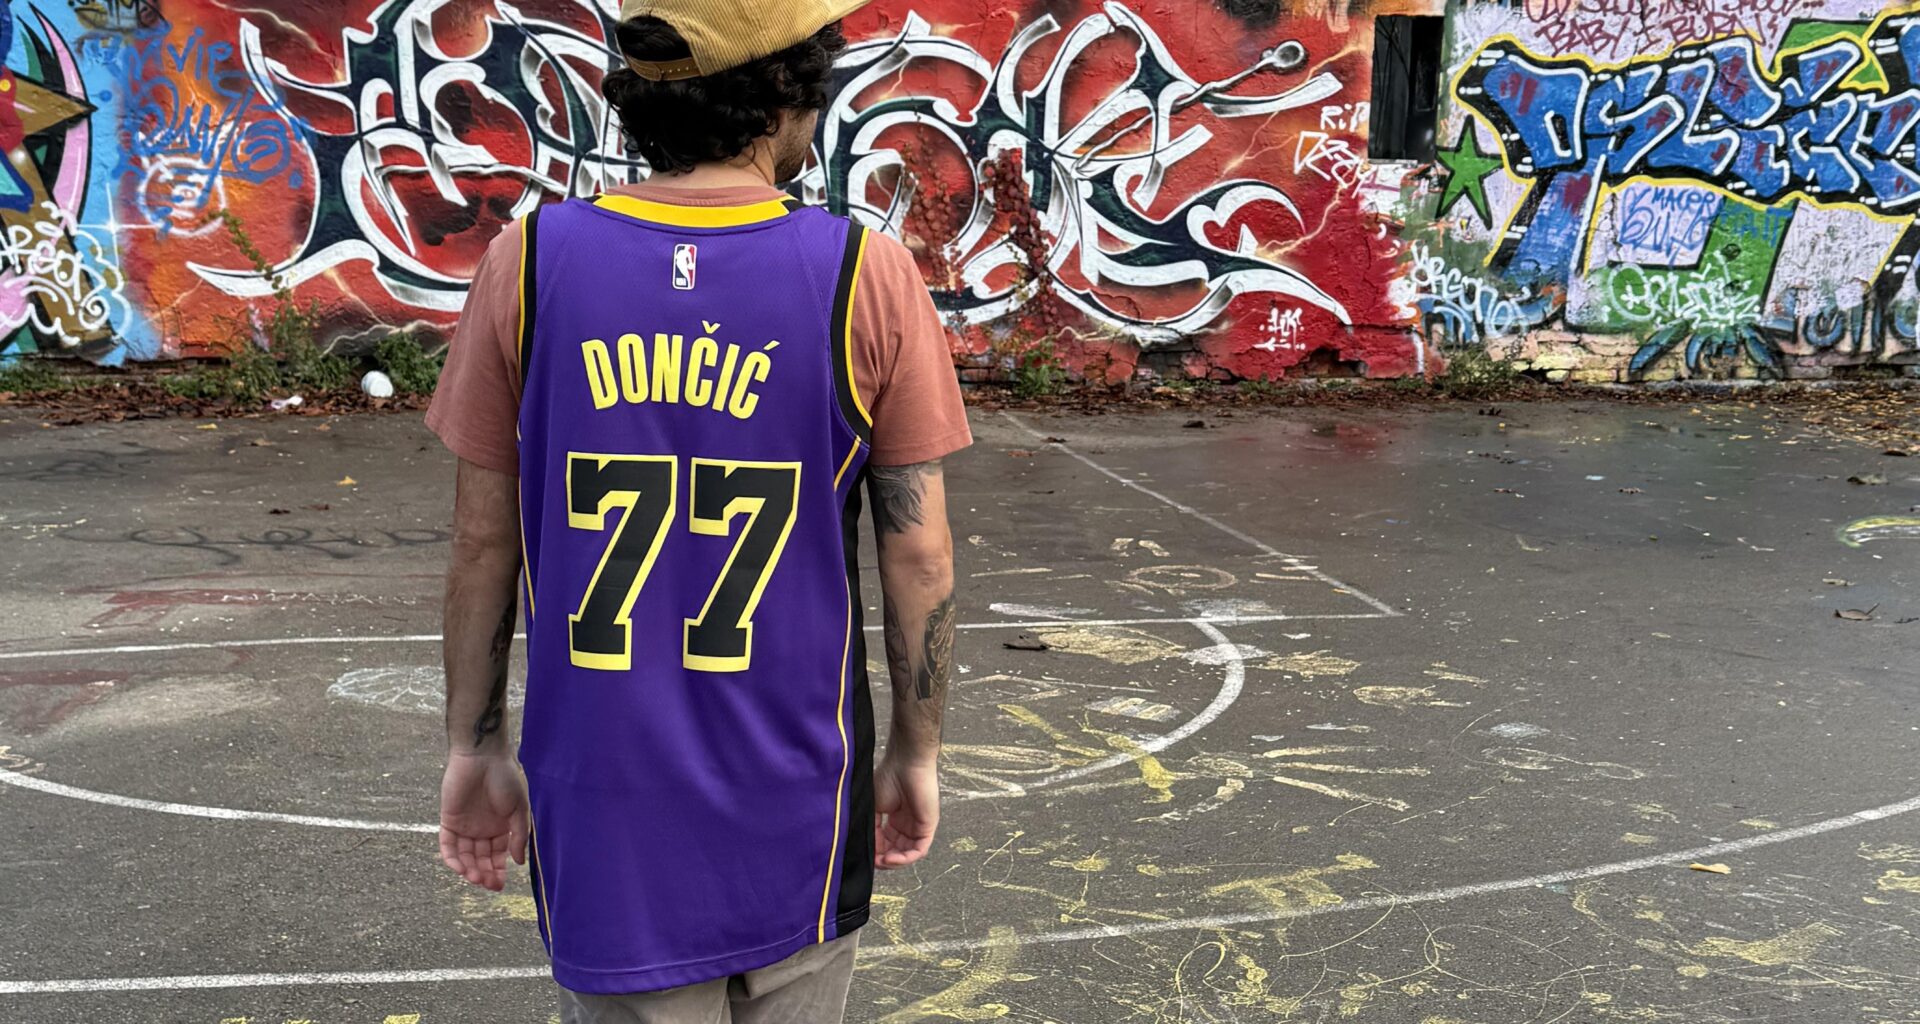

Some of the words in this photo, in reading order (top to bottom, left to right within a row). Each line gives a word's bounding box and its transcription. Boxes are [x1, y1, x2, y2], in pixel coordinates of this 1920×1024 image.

[1534, 15, 1631, 60] BABY
[581, 320, 780, 419] DONČIĆ
[566, 451, 802, 672] 77
